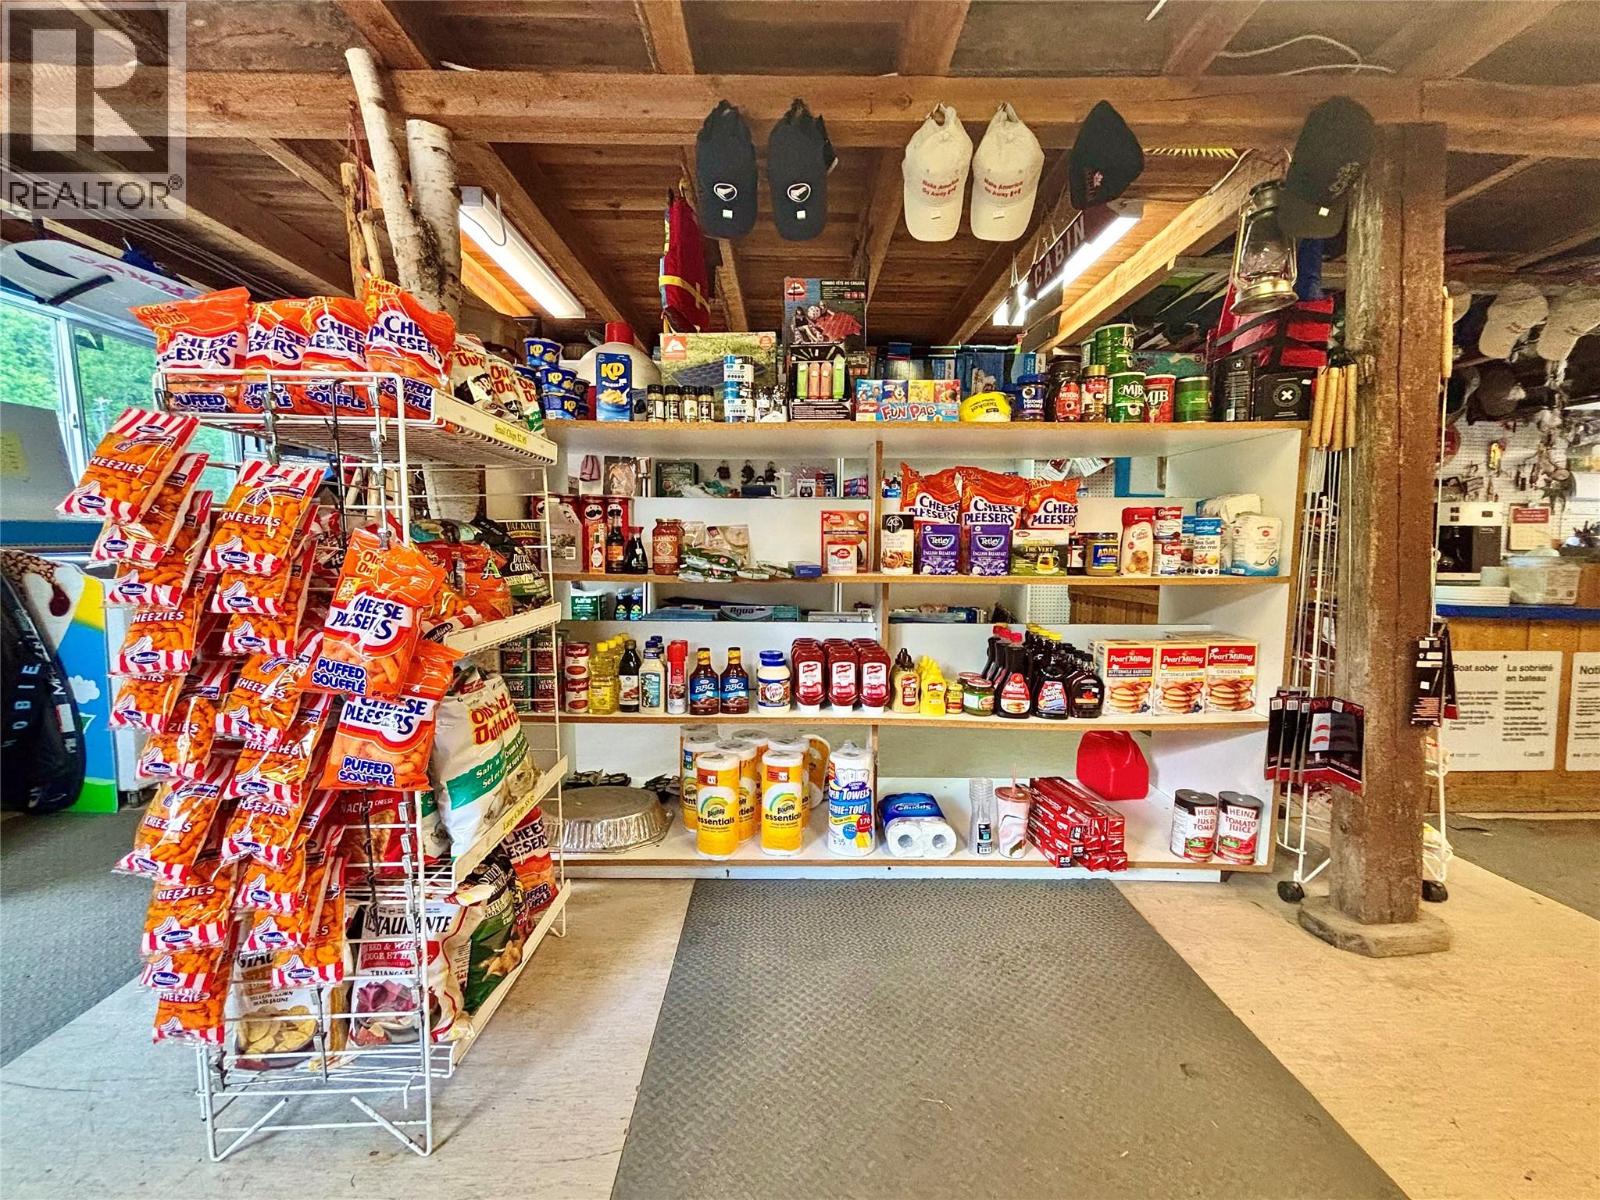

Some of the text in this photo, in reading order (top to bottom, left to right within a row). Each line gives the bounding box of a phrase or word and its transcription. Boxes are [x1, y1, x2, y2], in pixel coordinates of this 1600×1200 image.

[1034, 214, 1086, 289] CABIN
[384, 316, 424, 337] CHE
[1122, 337, 1134, 349] MJ
[1123, 385, 1143, 396] MJB
[1144, 389, 1169, 405] MJB
[881, 404, 907, 422] FUN
[90, 456, 145, 474] HEEZIES
[919, 495, 961, 513] CHEESE
[973, 497, 1019, 514] CHEESE
[964, 512, 1014, 529] PLEESERS
[930, 536, 950, 546] Tetley
[980, 537, 1000, 547] Tetley
[132, 611, 185, 623] HEEZIES
[1109, 655, 1152, 664] Pearl Milling
[1163, 655, 1204, 664] Pearl Milling
[1209, 652, 1254, 662] Pearl Milling
[317, 658, 365, 680] PUFFED
[1453, 664, 1499, 672] Boat sober
[1507, 664, 1517, 672] La
[1519, 674, 1547, 682] bateau
[695, 683, 715, 693] BBQ
[724, 682, 745, 692] BBQ
[344, 757, 392, 775] PUFFED
[843, 788, 870, 801] TOWELS
[765, 812, 802, 822] essentials
[1229, 807, 1256, 819] HEINZ
[697, 816, 735, 826] essentials
[1225, 816, 1257, 828] TOMATO
[502, 817, 545, 846] CHEES
[1229, 825, 1252, 834] JUICE
